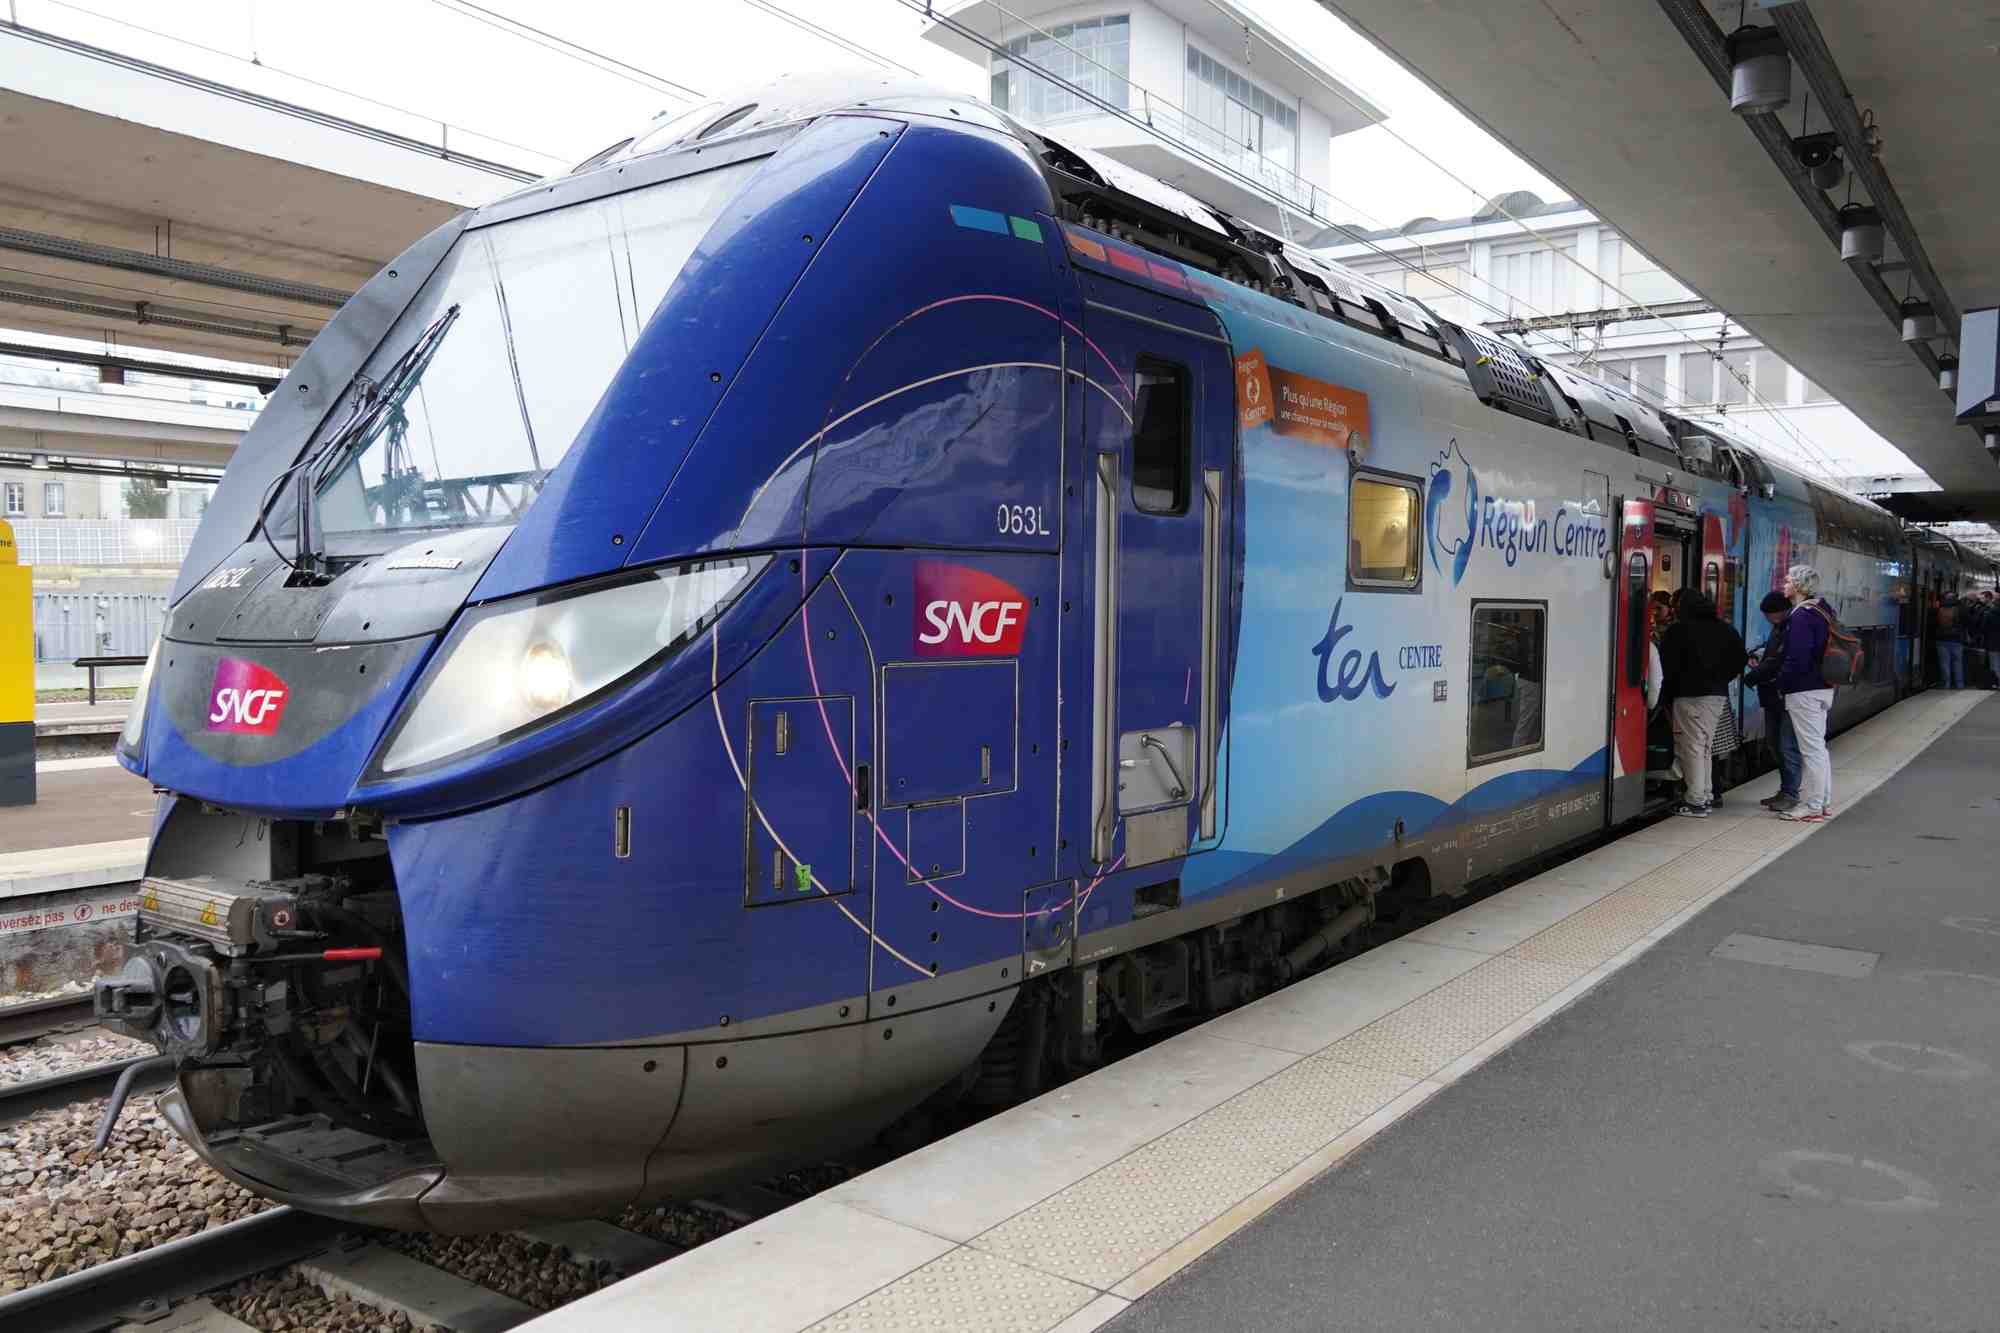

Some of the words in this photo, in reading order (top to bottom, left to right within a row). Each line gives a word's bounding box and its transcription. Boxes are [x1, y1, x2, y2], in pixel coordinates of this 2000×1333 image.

[997, 503, 1050, 535] 063L
[1553, 508, 1606, 559] Centre
[919, 600, 1022, 644] SNCF
[1312, 596, 1397, 703] ter
[1399, 645, 1442, 669] CENTRE
[210, 687, 283, 725] SNCF
[0, 914, 42, 929] versez
[44, 911, 64, 926] pas
[102, 902, 117, 913] ne
